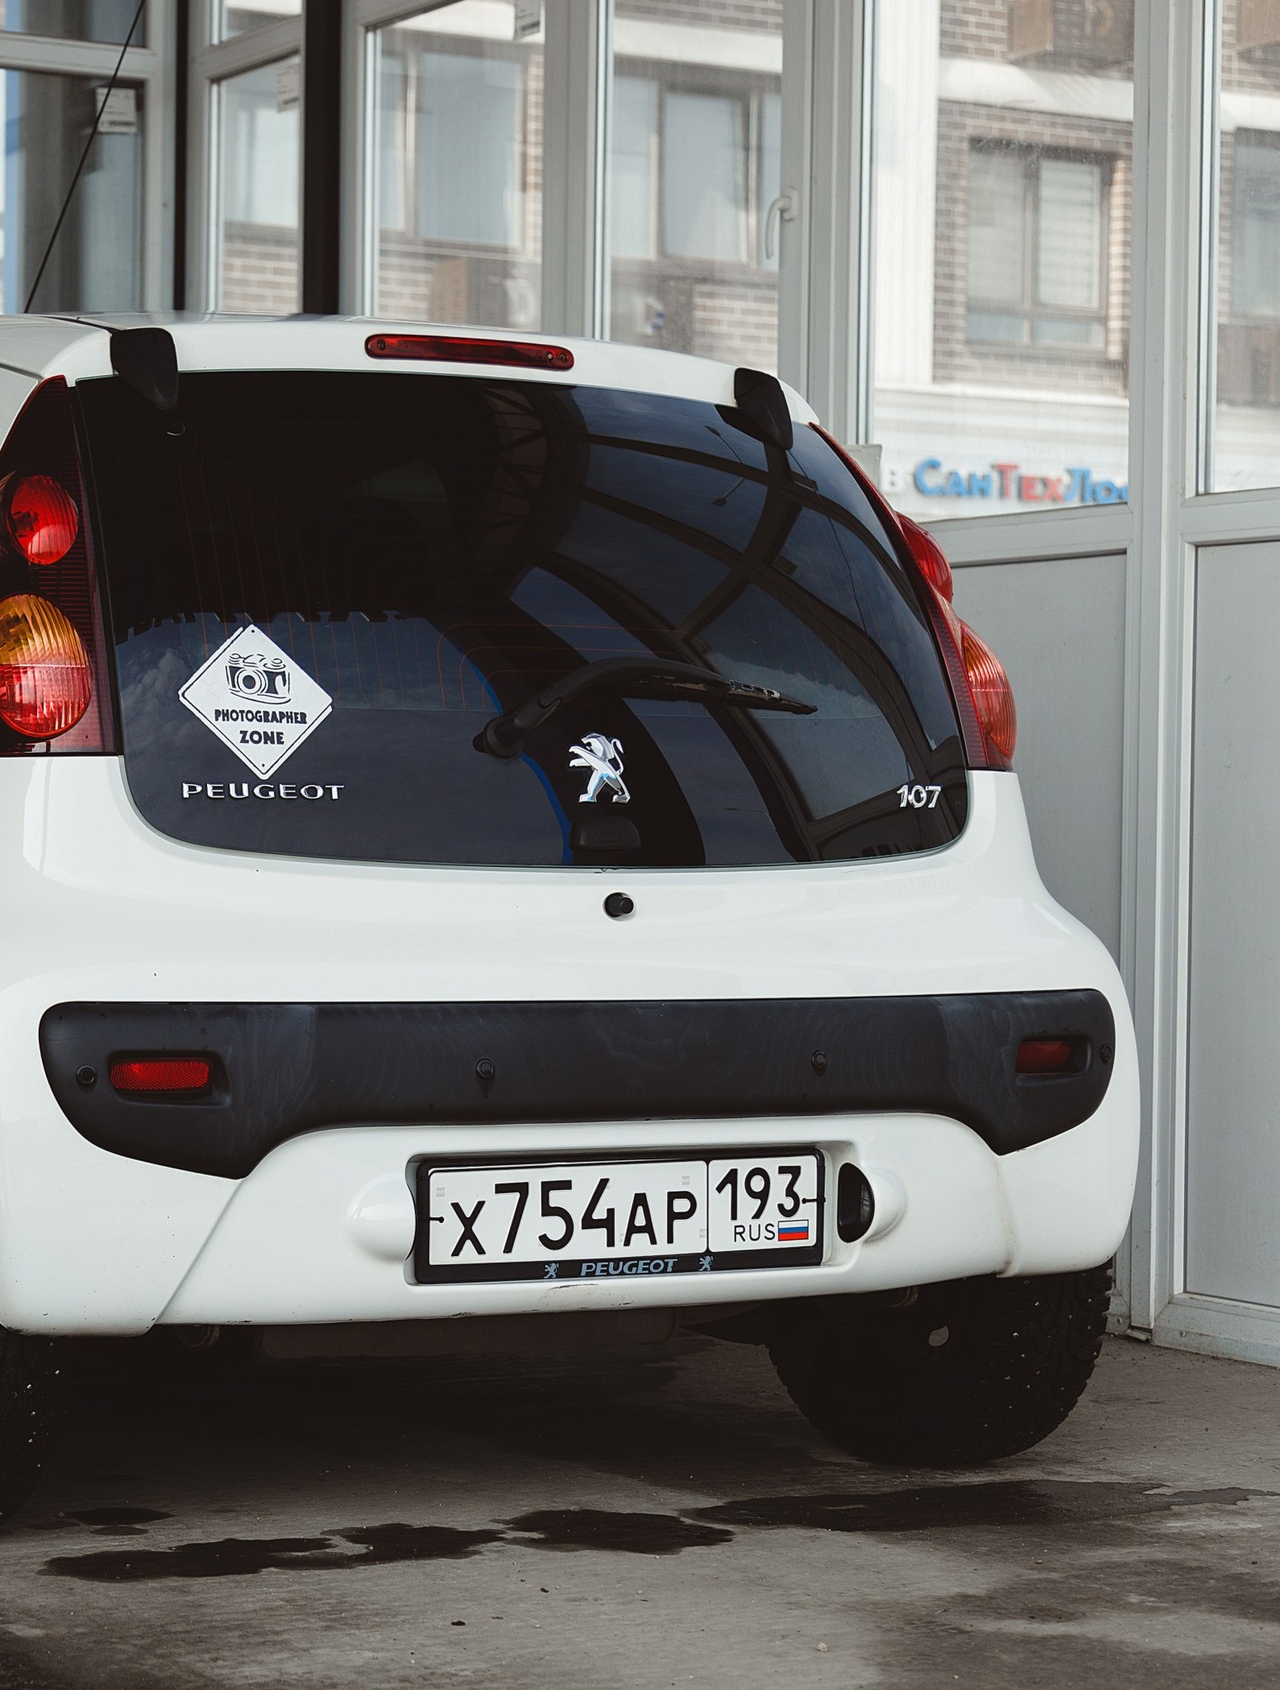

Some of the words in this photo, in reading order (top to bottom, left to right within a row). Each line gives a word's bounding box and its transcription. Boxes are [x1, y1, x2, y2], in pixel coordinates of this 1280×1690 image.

[214, 709, 308, 724] PHOTOGRAPHER
[239, 730, 285, 745] ZONE
[182, 782, 345, 800] PEUGEOT
[896, 784, 941, 809] 107
[715, 1165, 801, 1221] 193
[734, 1223, 776, 1242] RUS
[580, 1258, 679, 1277] PEUGEOT
